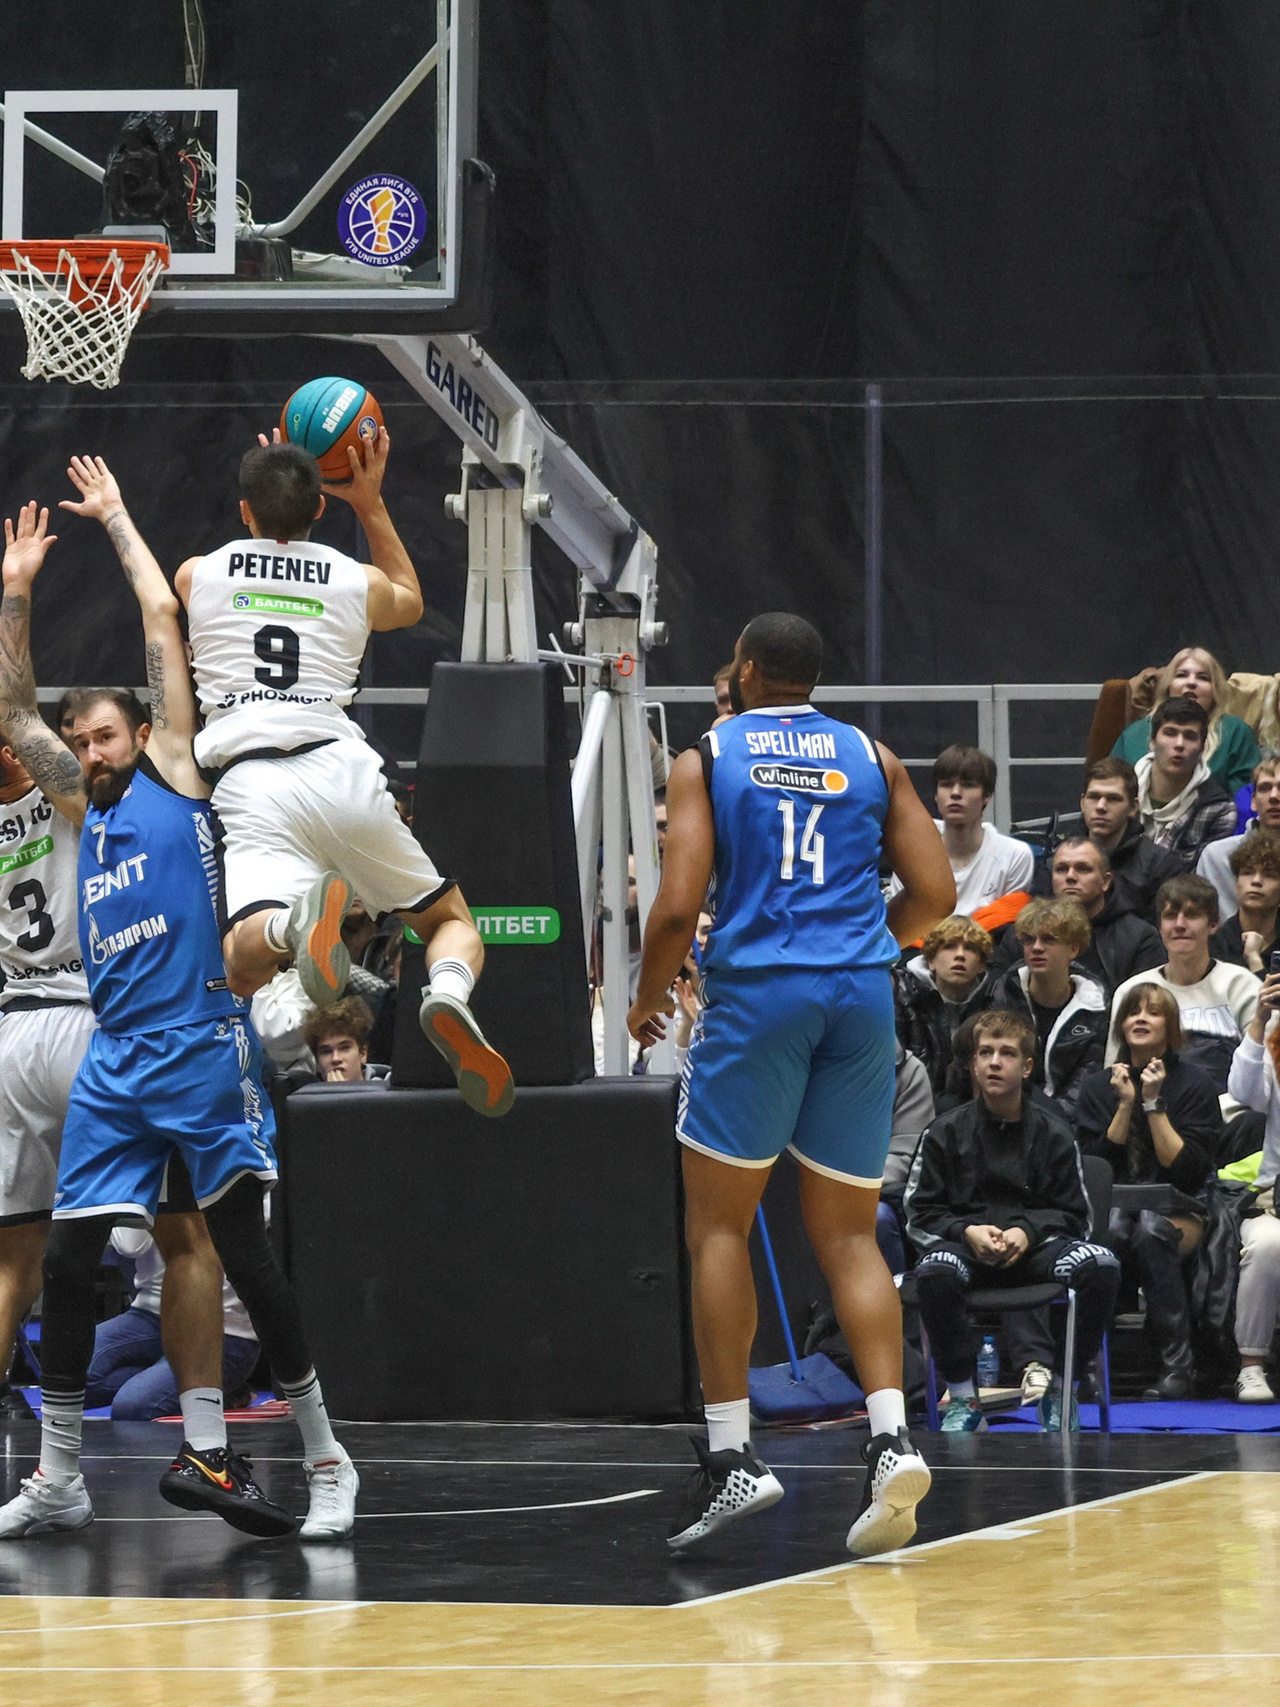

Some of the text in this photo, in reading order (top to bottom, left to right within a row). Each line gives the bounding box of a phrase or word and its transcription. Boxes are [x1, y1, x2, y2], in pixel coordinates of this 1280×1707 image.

[345, 177, 419, 205] ЕДИНАЯ ЛИГА ВТБ
[345, 236, 419, 265] VTB UNITED LEAGUE
[322, 386, 358, 434] SIBUR
[426, 340, 499, 452] GARED
[228, 553, 331, 585] PETENEV
[255, 599, 319, 613] БАЛТБЕТ
[254, 624, 300, 690] 9
[745, 731, 837, 759] SPELLMAN
[758, 769, 819, 788] Winline
[91, 822, 106, 865] 7
[777, 799, 825, 884] 14
[83, 852, 149, 914] ENIT
[8, 878, 55, 952] 3
